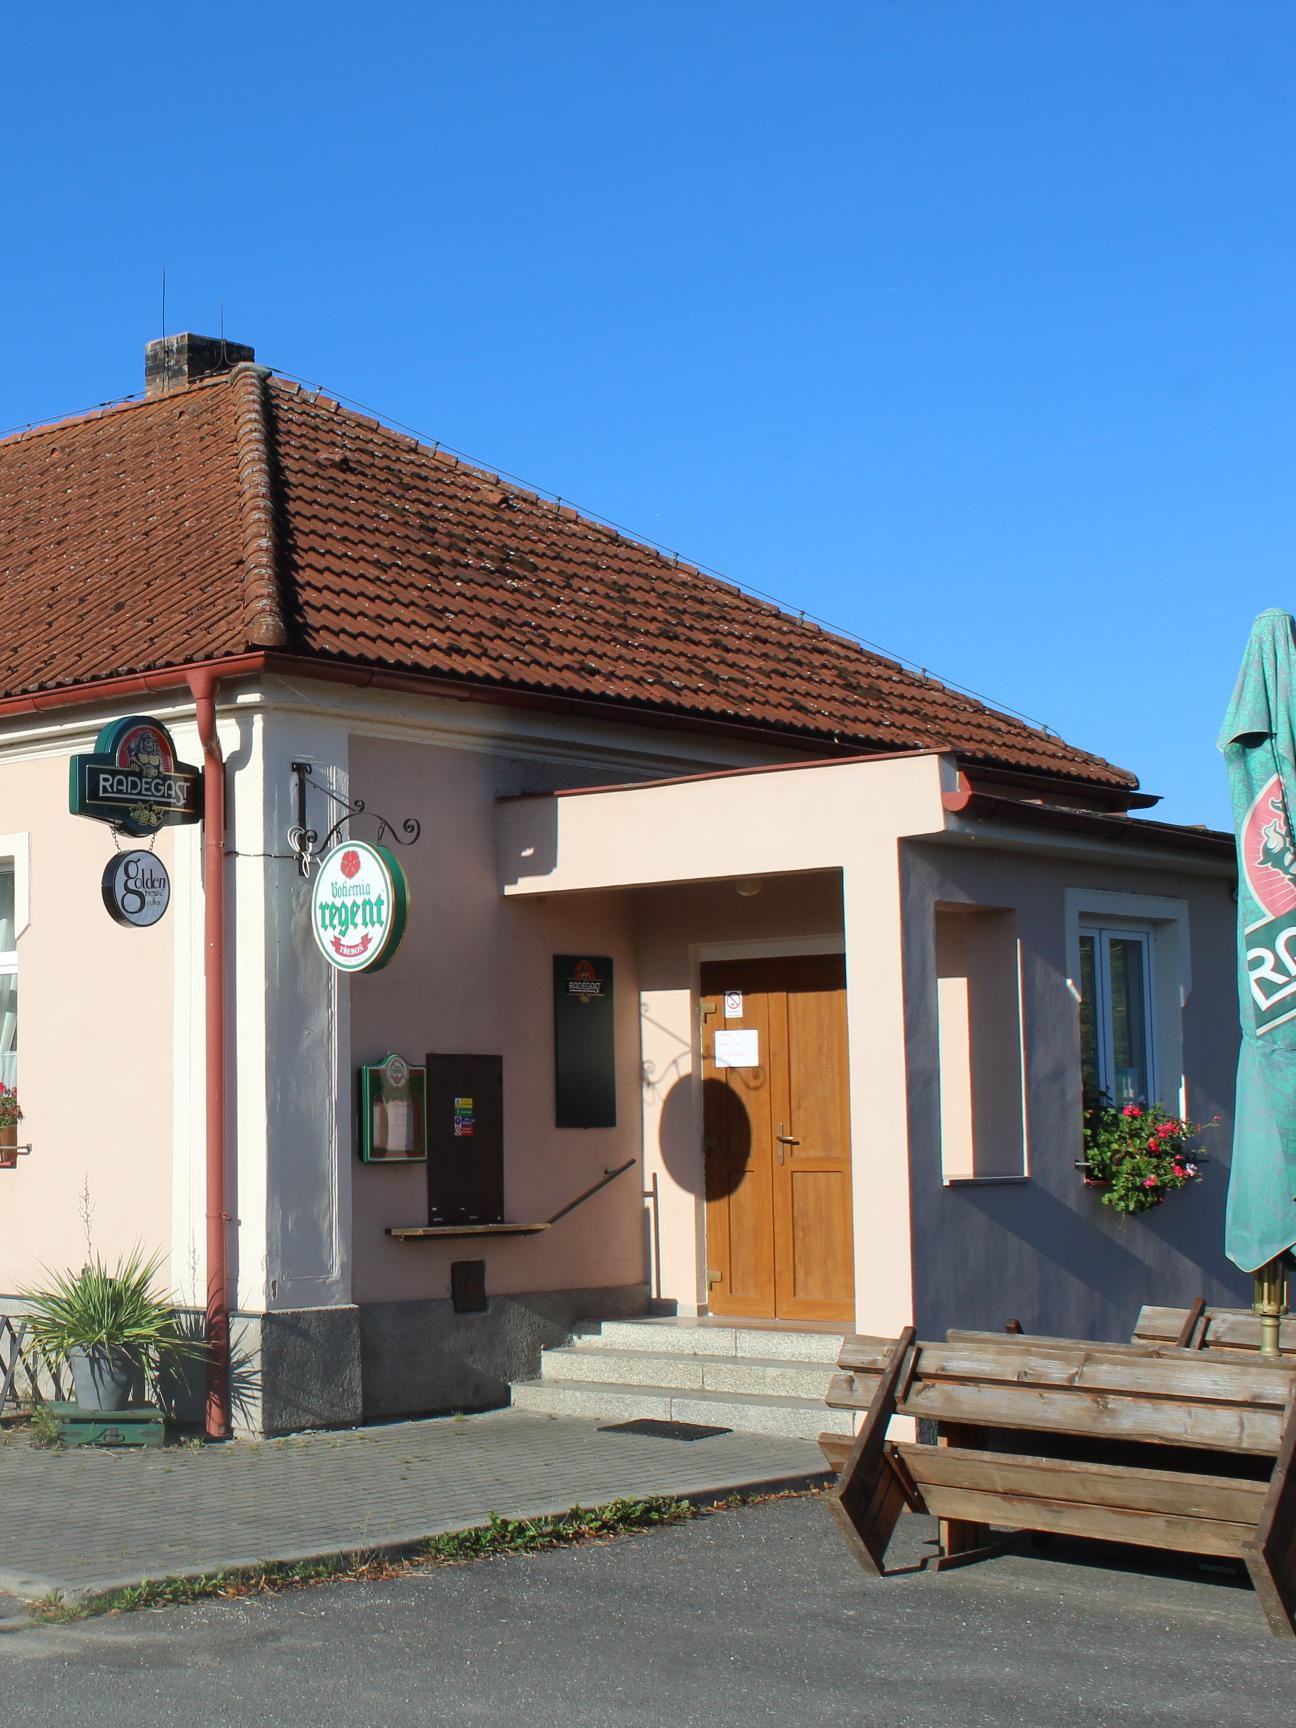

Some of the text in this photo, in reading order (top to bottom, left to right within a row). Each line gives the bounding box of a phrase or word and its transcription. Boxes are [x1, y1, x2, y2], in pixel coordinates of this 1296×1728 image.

[99, 774, 191, 806] RADEGAST
[121, 858, 166, 914] golden
[319, 893, 384, 937] regent
[568, 981, 602, 994] RADEGAST
